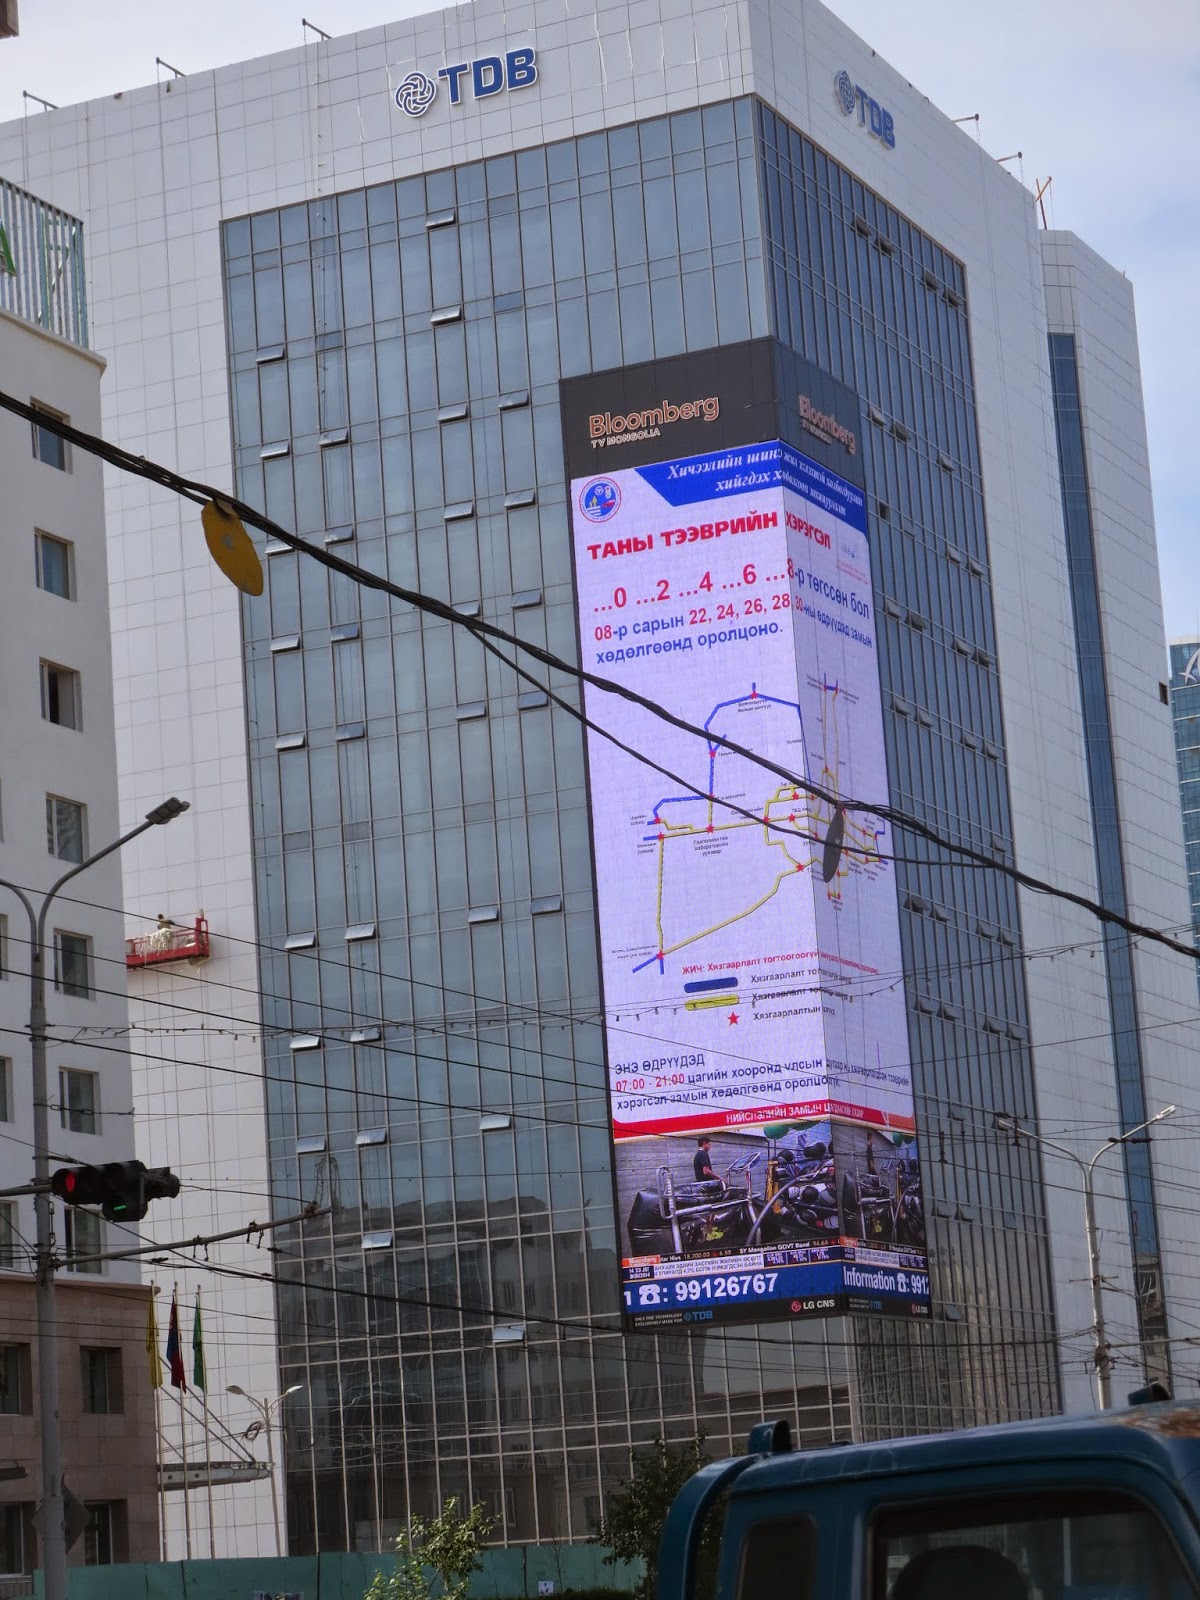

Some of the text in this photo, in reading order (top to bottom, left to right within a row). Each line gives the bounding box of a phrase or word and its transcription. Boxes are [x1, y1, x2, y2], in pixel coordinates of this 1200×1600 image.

[437, 47, 537, 105] TDB
[855, 84, 896, 149] TDB
[589, 397, 719, 438] Bloomberg
[799, 395, 855, 455] Bloomberg
[591, 428, 661, 448] TV MONGOLIA
[667, 454, 742, 479] Хичээлийн
[716, 471, 770, 491] хийгдэх
[587, 510, 831, 560] ТАНЫ ТЭЭВРИЙН ХЭРЭГСЭЛ
[807, 573, 848, 608] төгссөн
[851, 592, 870, 620] бол
[594, 624, 627, 641] 08-р
[633, 615, 684, 636] сарын
[689, 608, 712, 625] 22,
[717, 603, 739, 620] 24,
[744, 598, 767, 615] 26,
[851, 626, 873, 649] замын
[596, 622, 783, 664] хөдөлгөөнд оролцоно.
[708, 958, 760, 972] Хязгаарлалт
[751, 970, 804, 983] Хязгаарлалт
[753, 1007, 820, 1020] Хязгаарлалтын
[615, 1054, 705, 1075] ЭНЭ ӨДРҮҮДЭД
[616, 1079, 645, 1092] 07:00
[655, 1074, 685, 1089] 21:00
[688, 1069, 728, 1084] цагийн
[732, 1064, 782, 1078] хооронд
[785, 1059, 822, 1071] улсын
[617, 1095, 667, 1111] хэрэгсэл
[670, 1090, 707, 1104] замын
[712, 1082, 782, 1099] хөдөлгөөнд
[726, 1107, 787, 1123] НИЙСЛЭЛИЙН
[789, 1103, 822, 1116] ЗАМЫН
[675, 1273, 778, 1302] 99126767
[843, 1265, 895, 1291] Information
[693, 1310, 713, 1321] TDB
[803, 1299, 835, 1310] LG CNS
